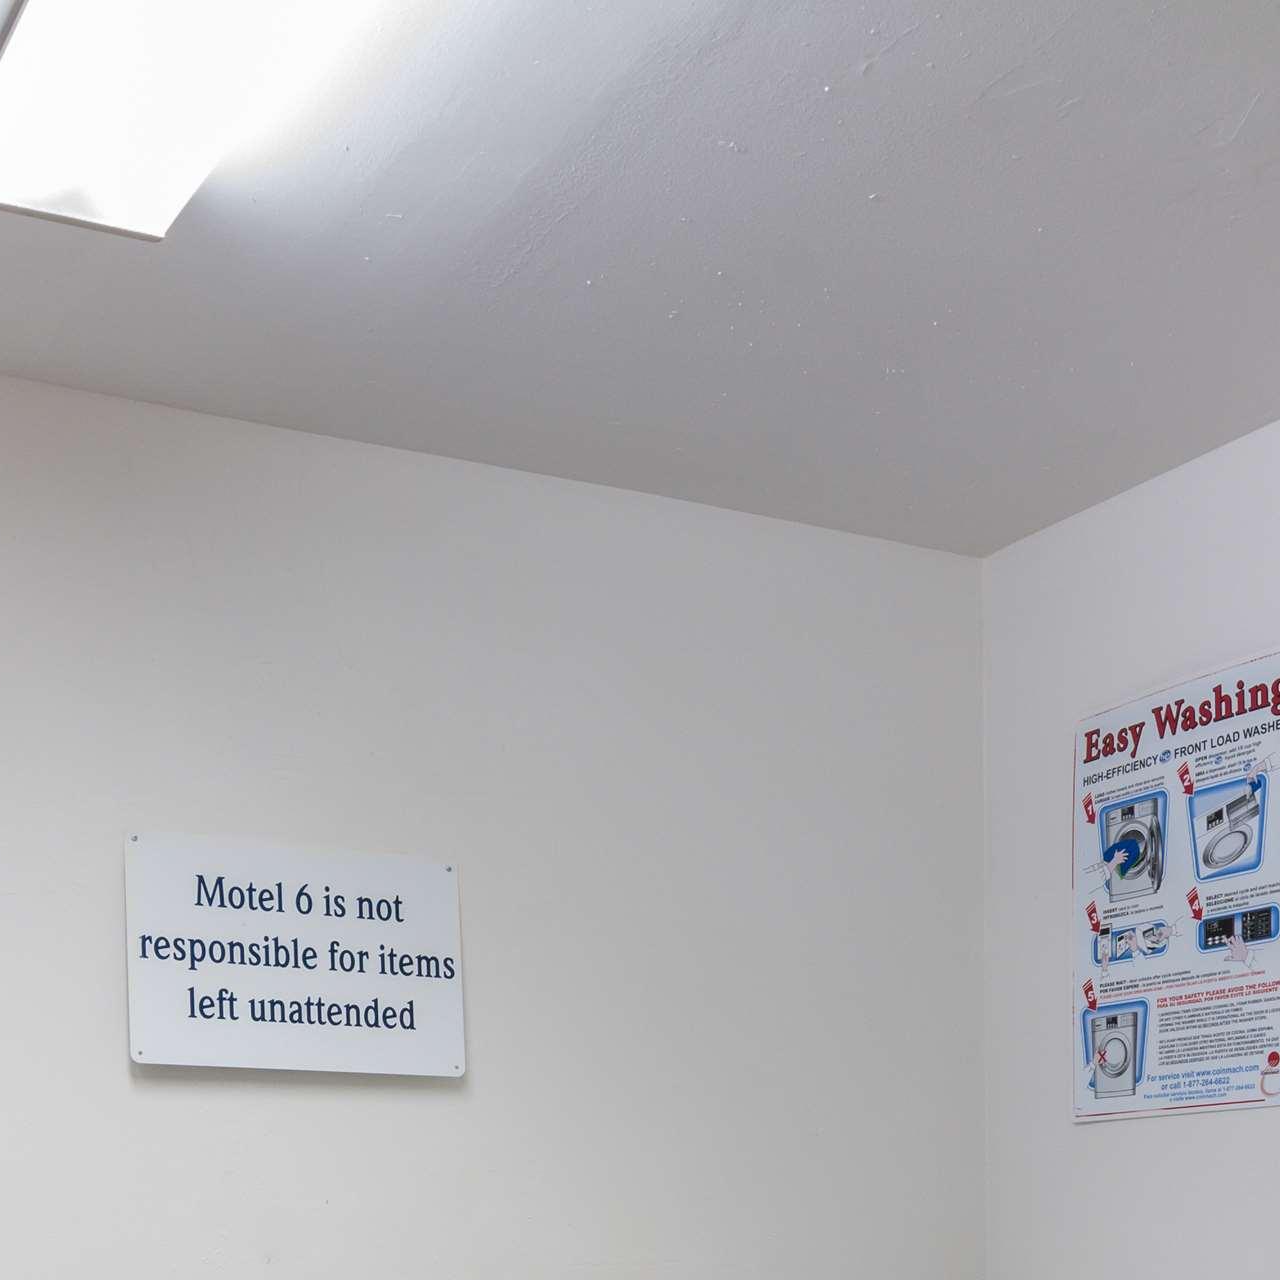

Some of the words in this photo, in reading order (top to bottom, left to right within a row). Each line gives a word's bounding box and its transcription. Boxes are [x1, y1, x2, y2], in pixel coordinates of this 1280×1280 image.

[1083, 722, 1145, 764] Easy
[1082, 755, 1159, 787] HIGH-EFFICIENCY
[1174, 740, 1208, 759] FRONT
[1211, 730, 1239, 749] LOAD
[1183, 775, 1190, 785] 2
[194, 873, 285, 913] Motel
[295, 883, 313, 915] 6
[324, 885, 346, 918] is
[356, 894, 405, 923] not
[1091, 915, 1097, 924] 3
[138, 933, 318, 970] responsible
[328, 940, 370, 974] for
[378, 944, 456, 980] items
[1087, 994, 1094, 1003] 5
[1184, 991, 1204, 1000] SAFETY
[1206, 988, 1226, 997] PLEASE
[1228, 985, 1244, 993] AVOID
[186, 987, 239, 1020] left
[248, 997, 417, 1031] unattended
[1146, 1074, 1158, 1082] For
[1160, 1072, 1180, 1081] service
[1181, 1070, 1196, 1079] visit
[1169, 1081, 1182, 1090] call
